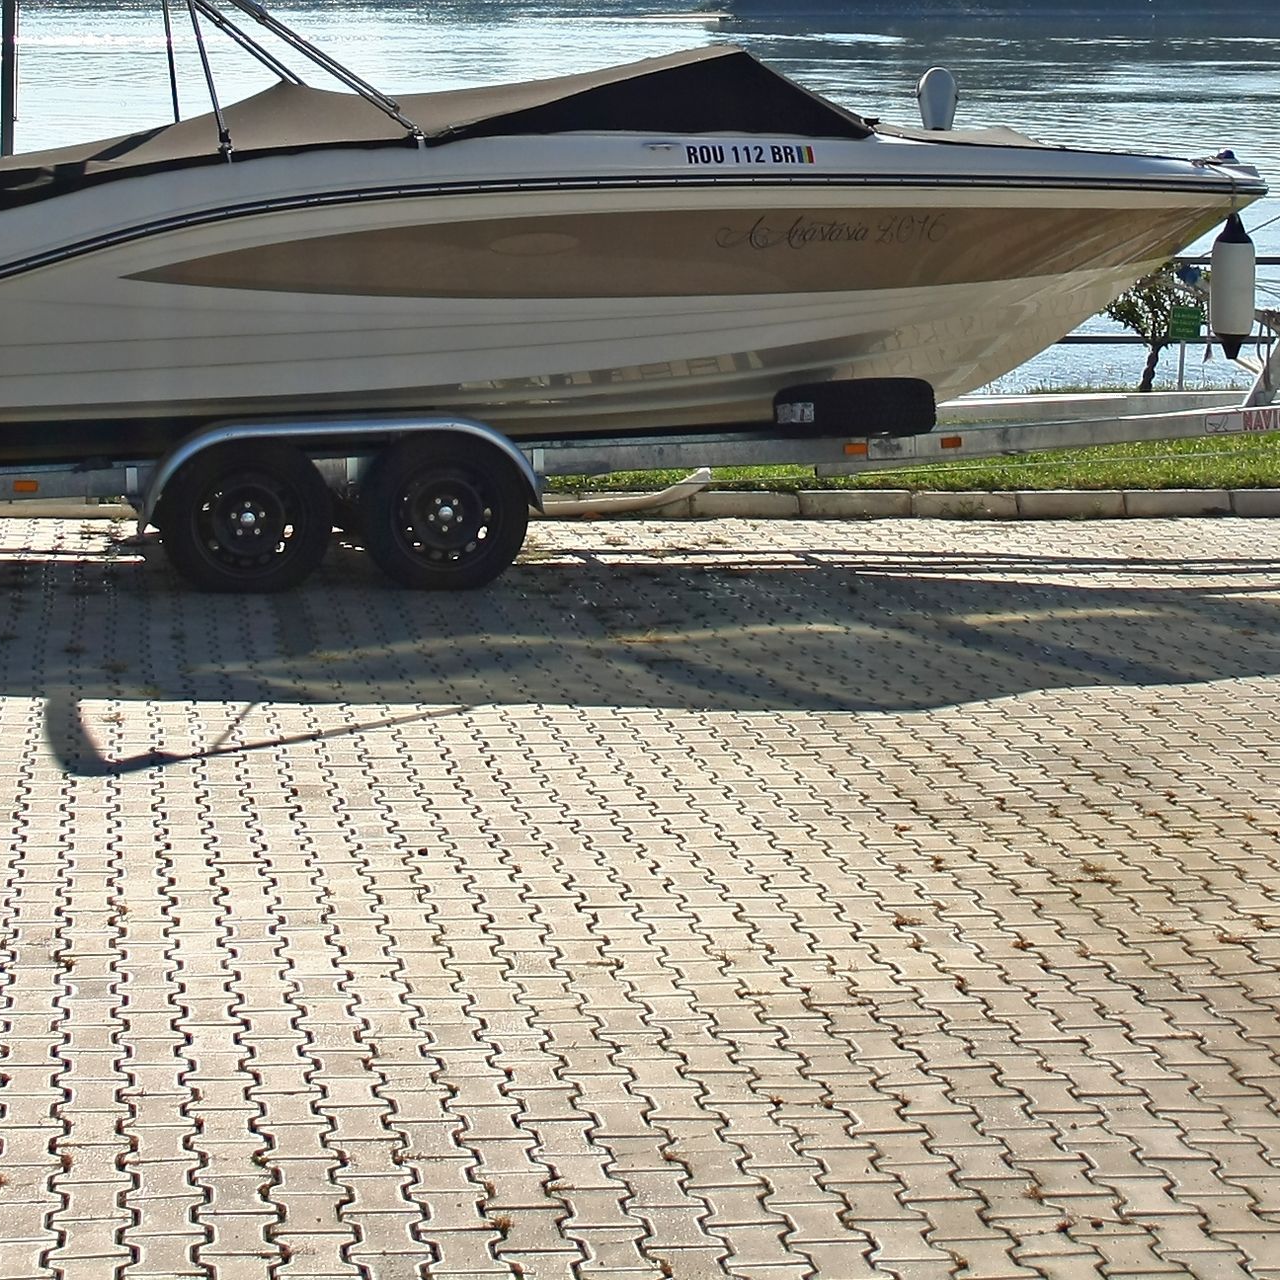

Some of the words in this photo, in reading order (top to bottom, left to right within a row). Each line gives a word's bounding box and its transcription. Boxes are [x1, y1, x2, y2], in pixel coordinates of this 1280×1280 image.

[686, 145, 725, 164] ROU
[731, 145, 766, 164] 112
[770, 145, 796, 164] BR
